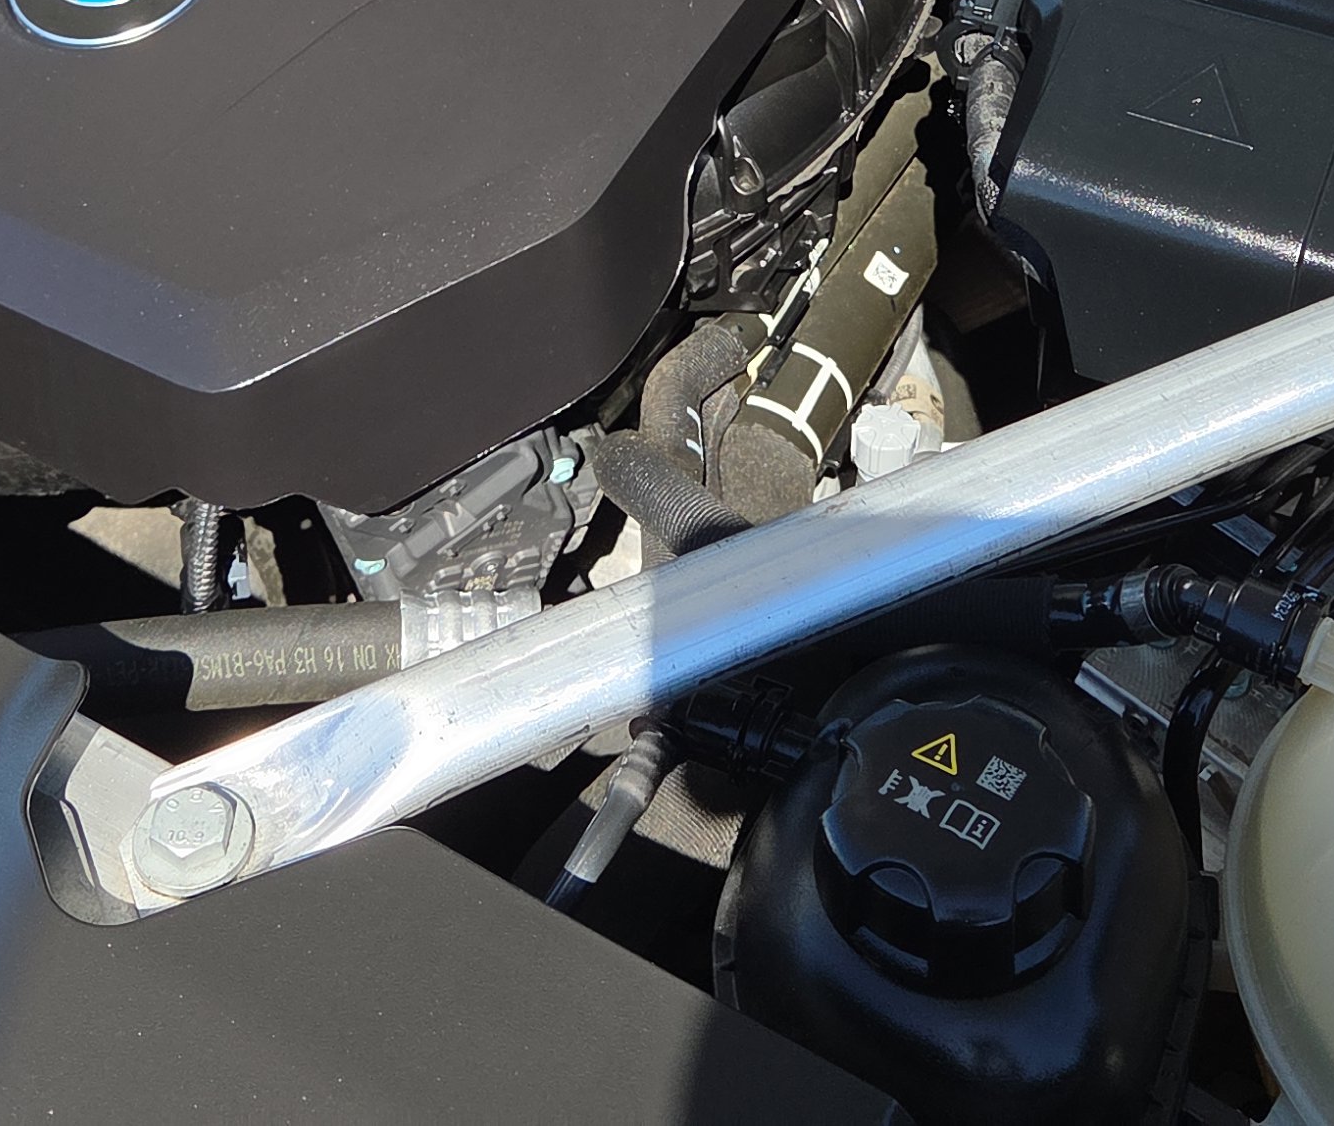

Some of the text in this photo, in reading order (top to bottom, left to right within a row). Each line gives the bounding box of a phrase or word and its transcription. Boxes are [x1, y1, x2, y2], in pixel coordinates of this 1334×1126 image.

[293, 646, 318, 674] H3
[324, 645, 344, 673] 16
[353, 644, 378, 671] DN
